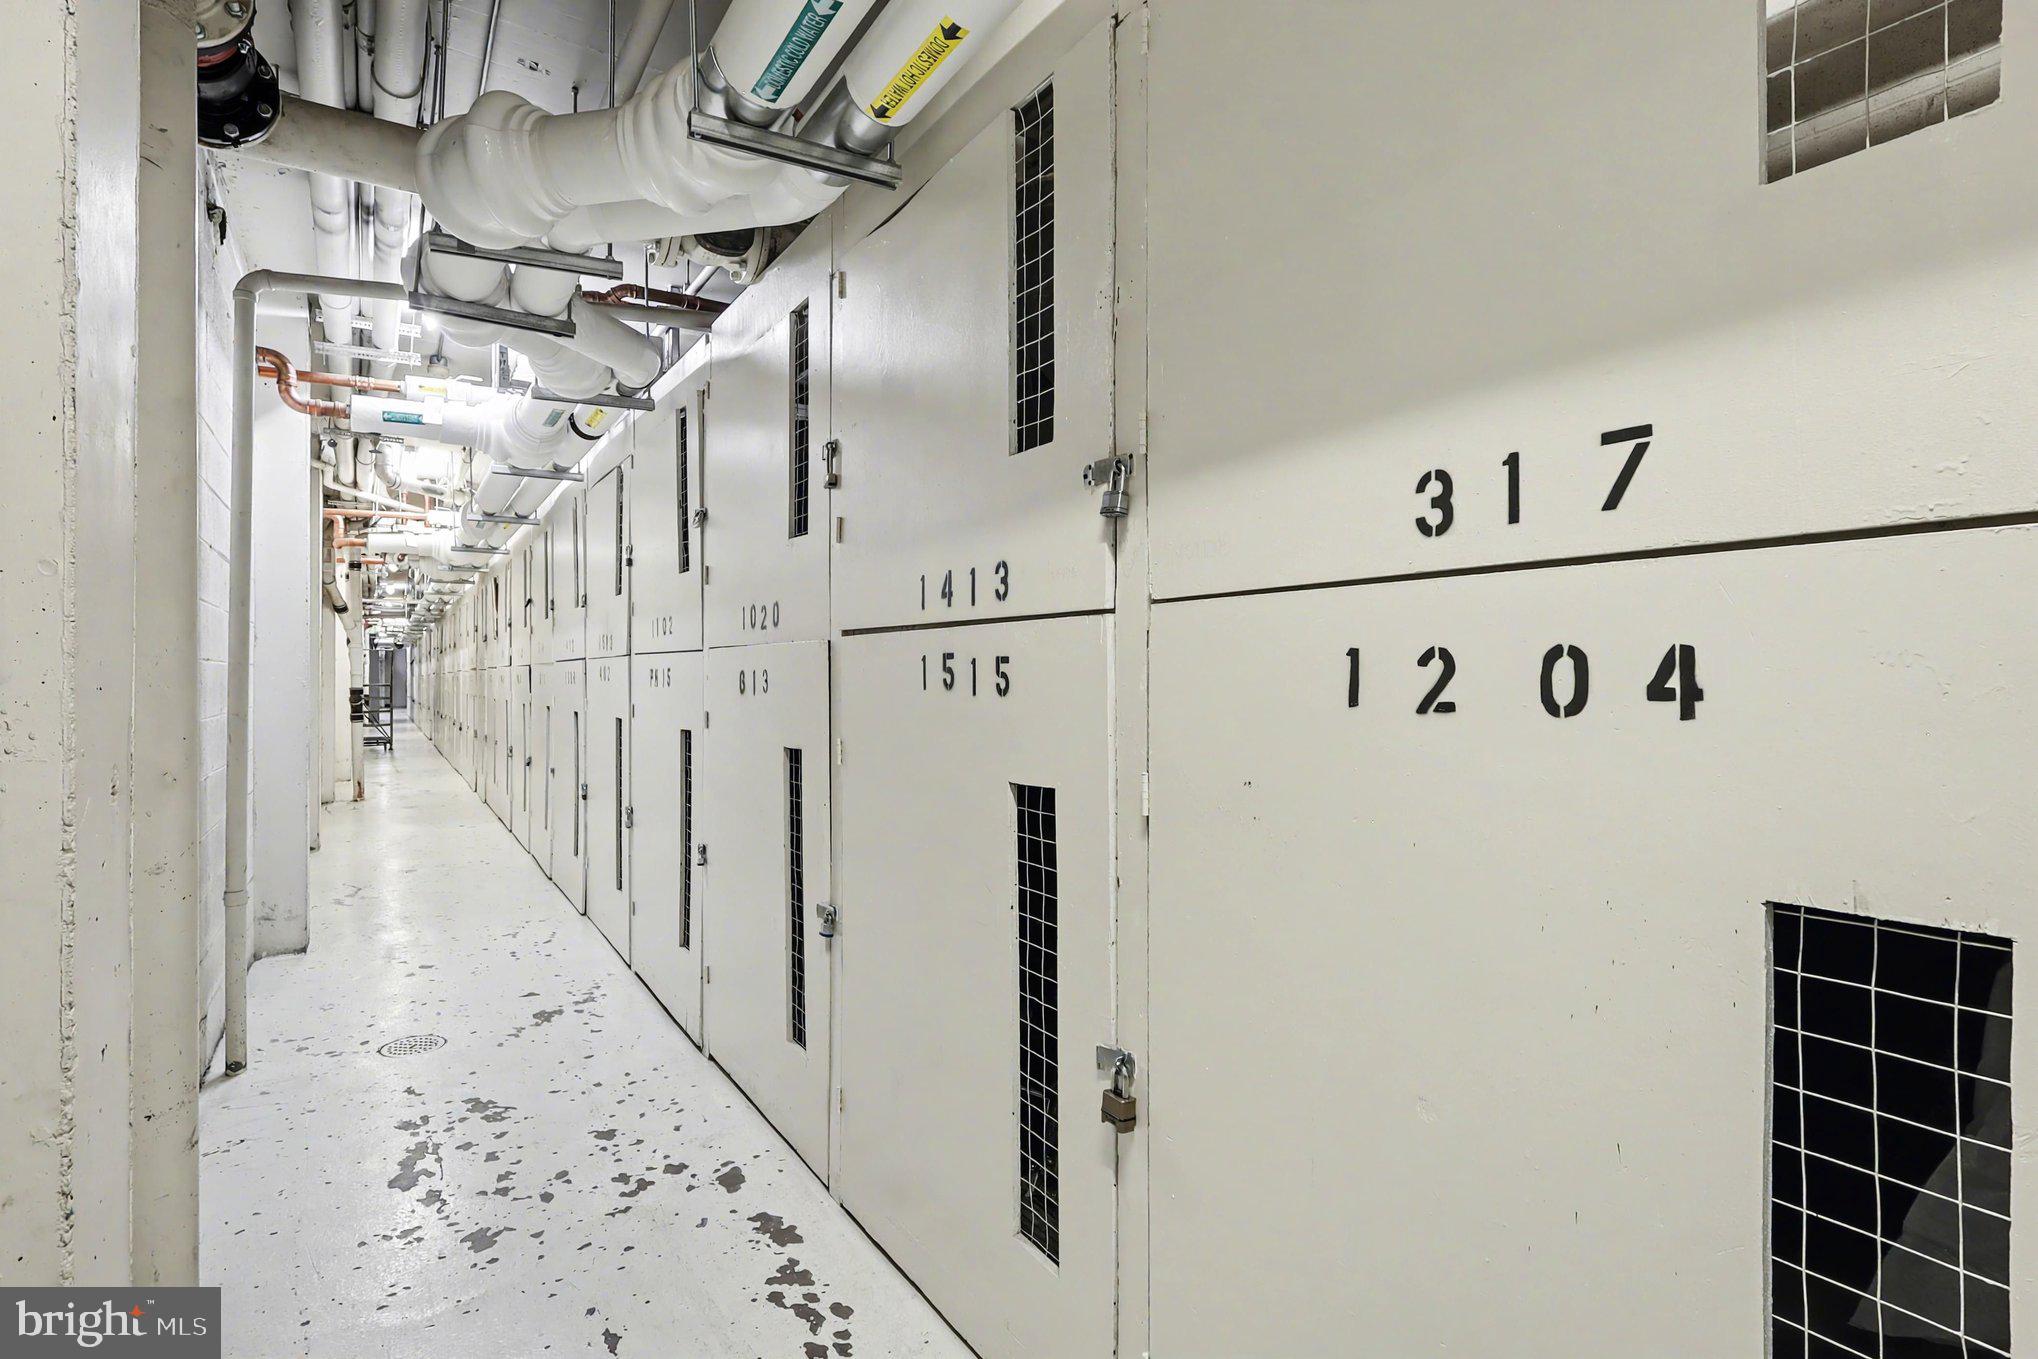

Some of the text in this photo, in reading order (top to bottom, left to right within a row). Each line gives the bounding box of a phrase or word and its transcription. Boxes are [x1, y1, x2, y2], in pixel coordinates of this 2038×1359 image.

[765, 11, 827, 90] DOMESTIC COLD WATER
[880, 36, 950, 110] DOMESTIC HOT WATER
[1415, 423, 1654, 537] 317
[742, 600, 779, 631] 1020
[920, 559, 1009, 610] 1413
[921, 652, 1010, 697] 1515
[1345, 643, 1704, 721] 1204
